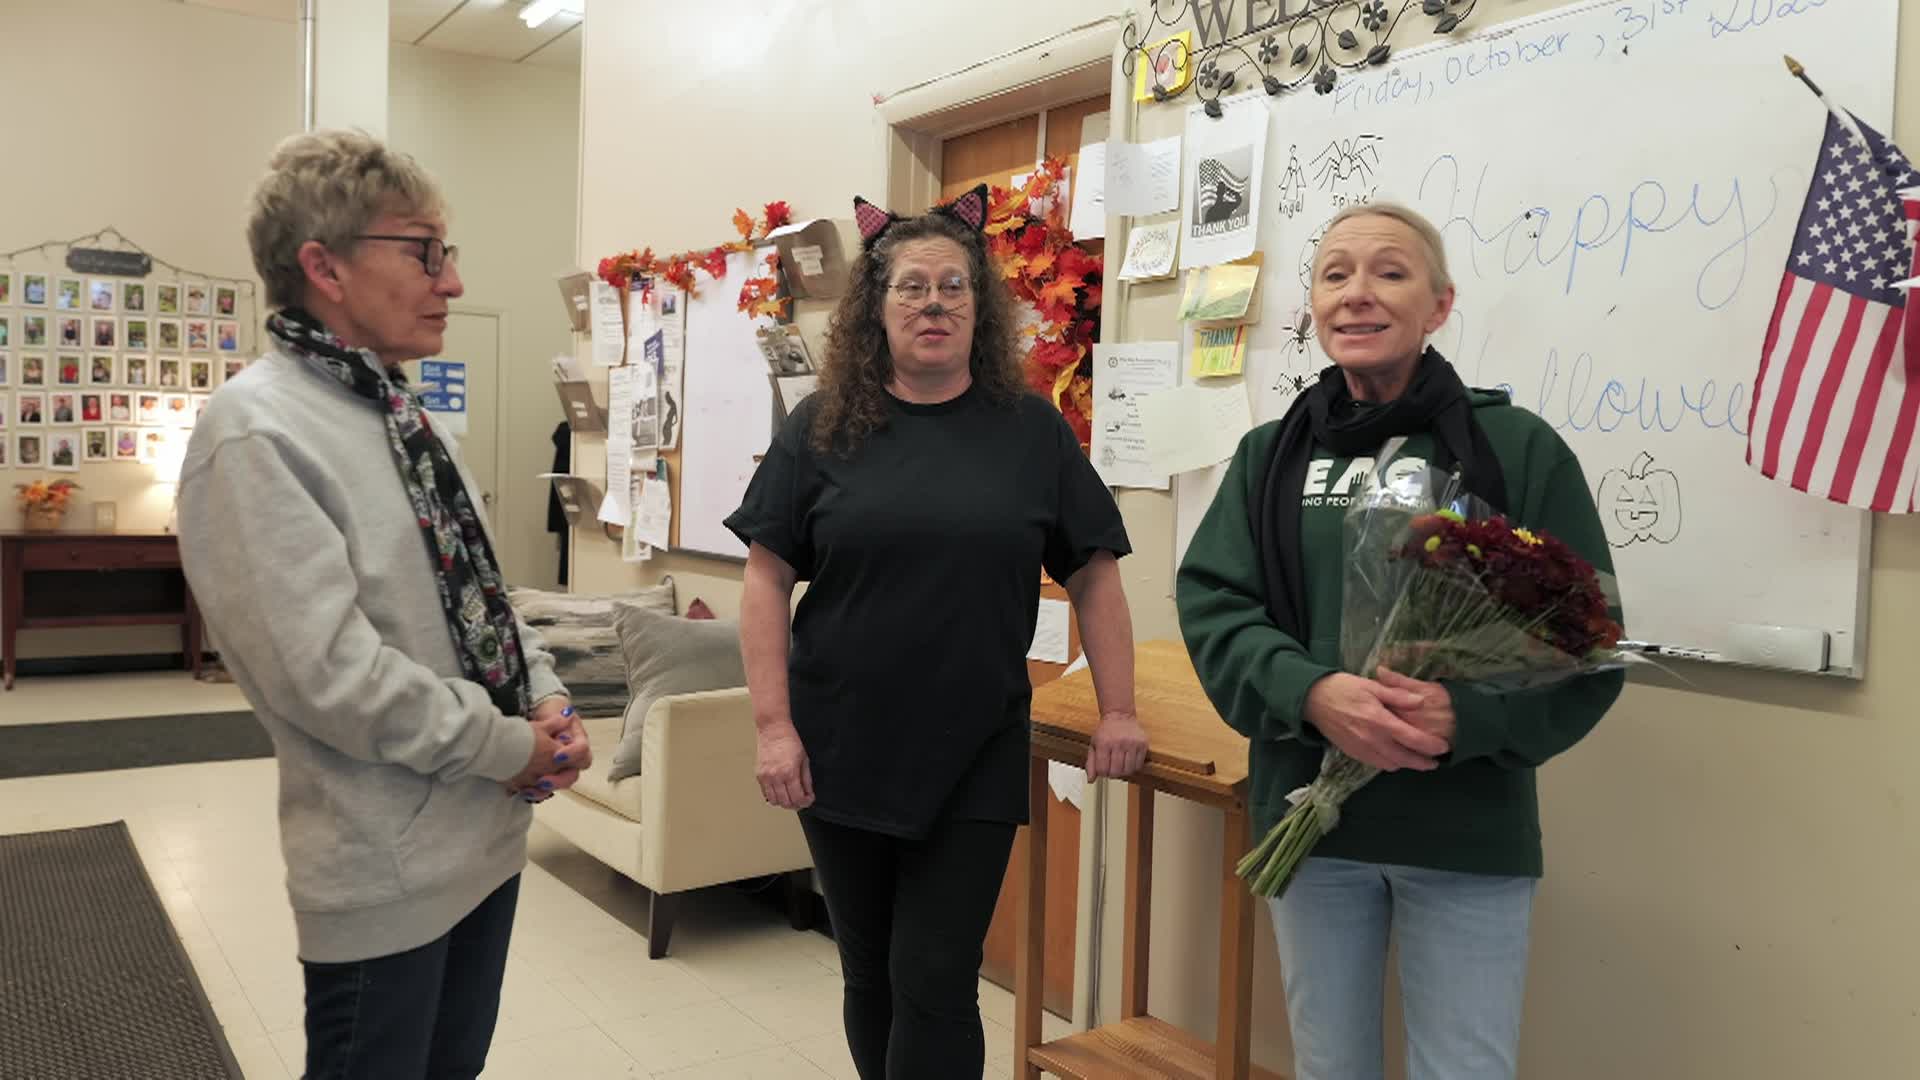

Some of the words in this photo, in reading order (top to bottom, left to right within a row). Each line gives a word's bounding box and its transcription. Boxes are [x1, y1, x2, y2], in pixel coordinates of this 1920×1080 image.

[1192, 220, 1227, 238] THANK
[1419, 154, 1778, 310] Happy
[1200, 327, 1236, 349] THANK
